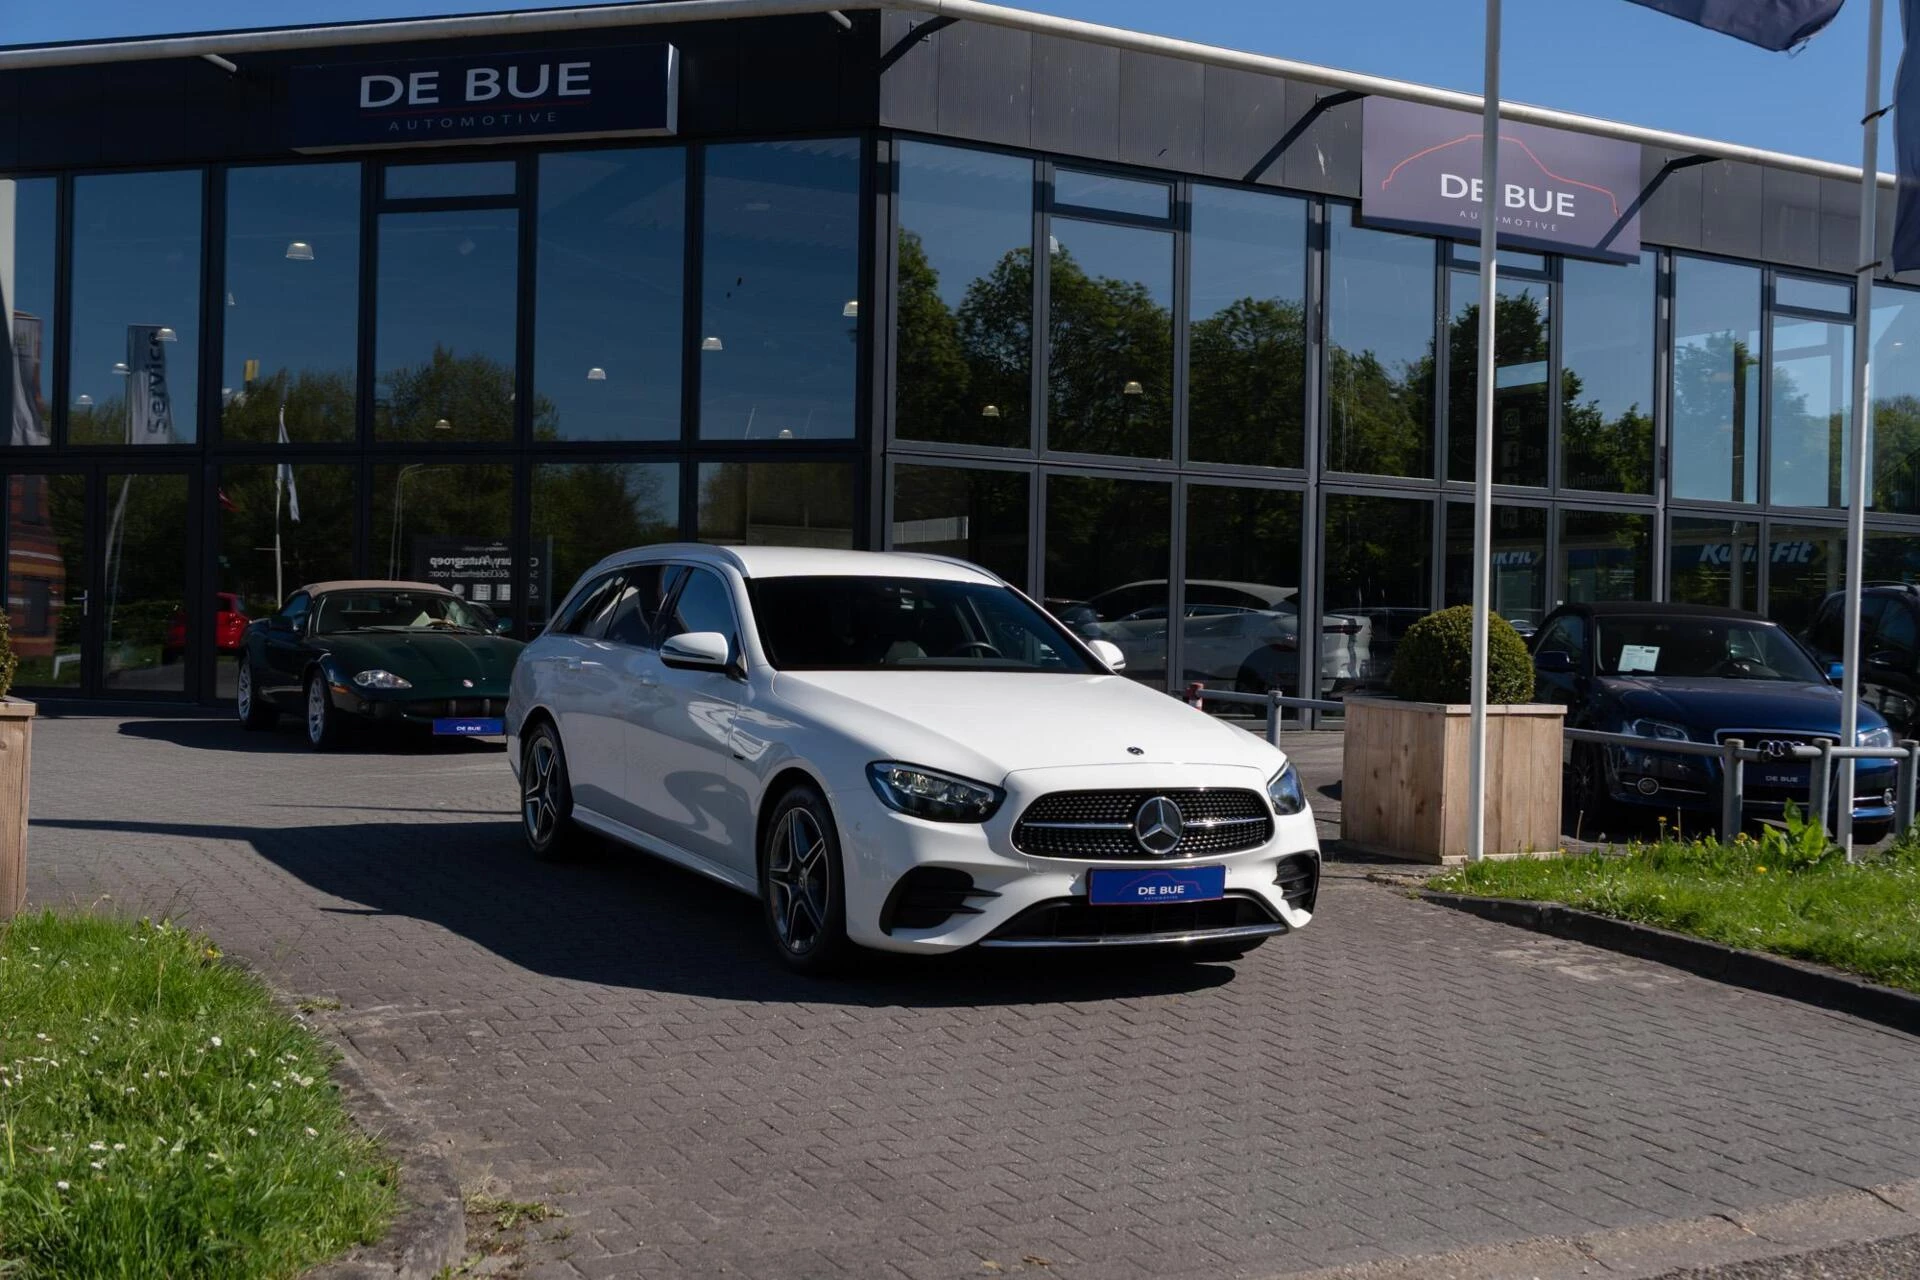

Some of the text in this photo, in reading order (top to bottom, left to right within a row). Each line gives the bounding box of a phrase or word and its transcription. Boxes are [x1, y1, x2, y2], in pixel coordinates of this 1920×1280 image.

[359, 61, 592, 109] DE BUE
[388, 111, 558, 132] AUTOMOTIVE
[1441, 173, 1576, 218] DE BUE
[1460, 210, 1558, 232] AUMOTIVE
[1137, 885, 1185, 896] DE BUE
